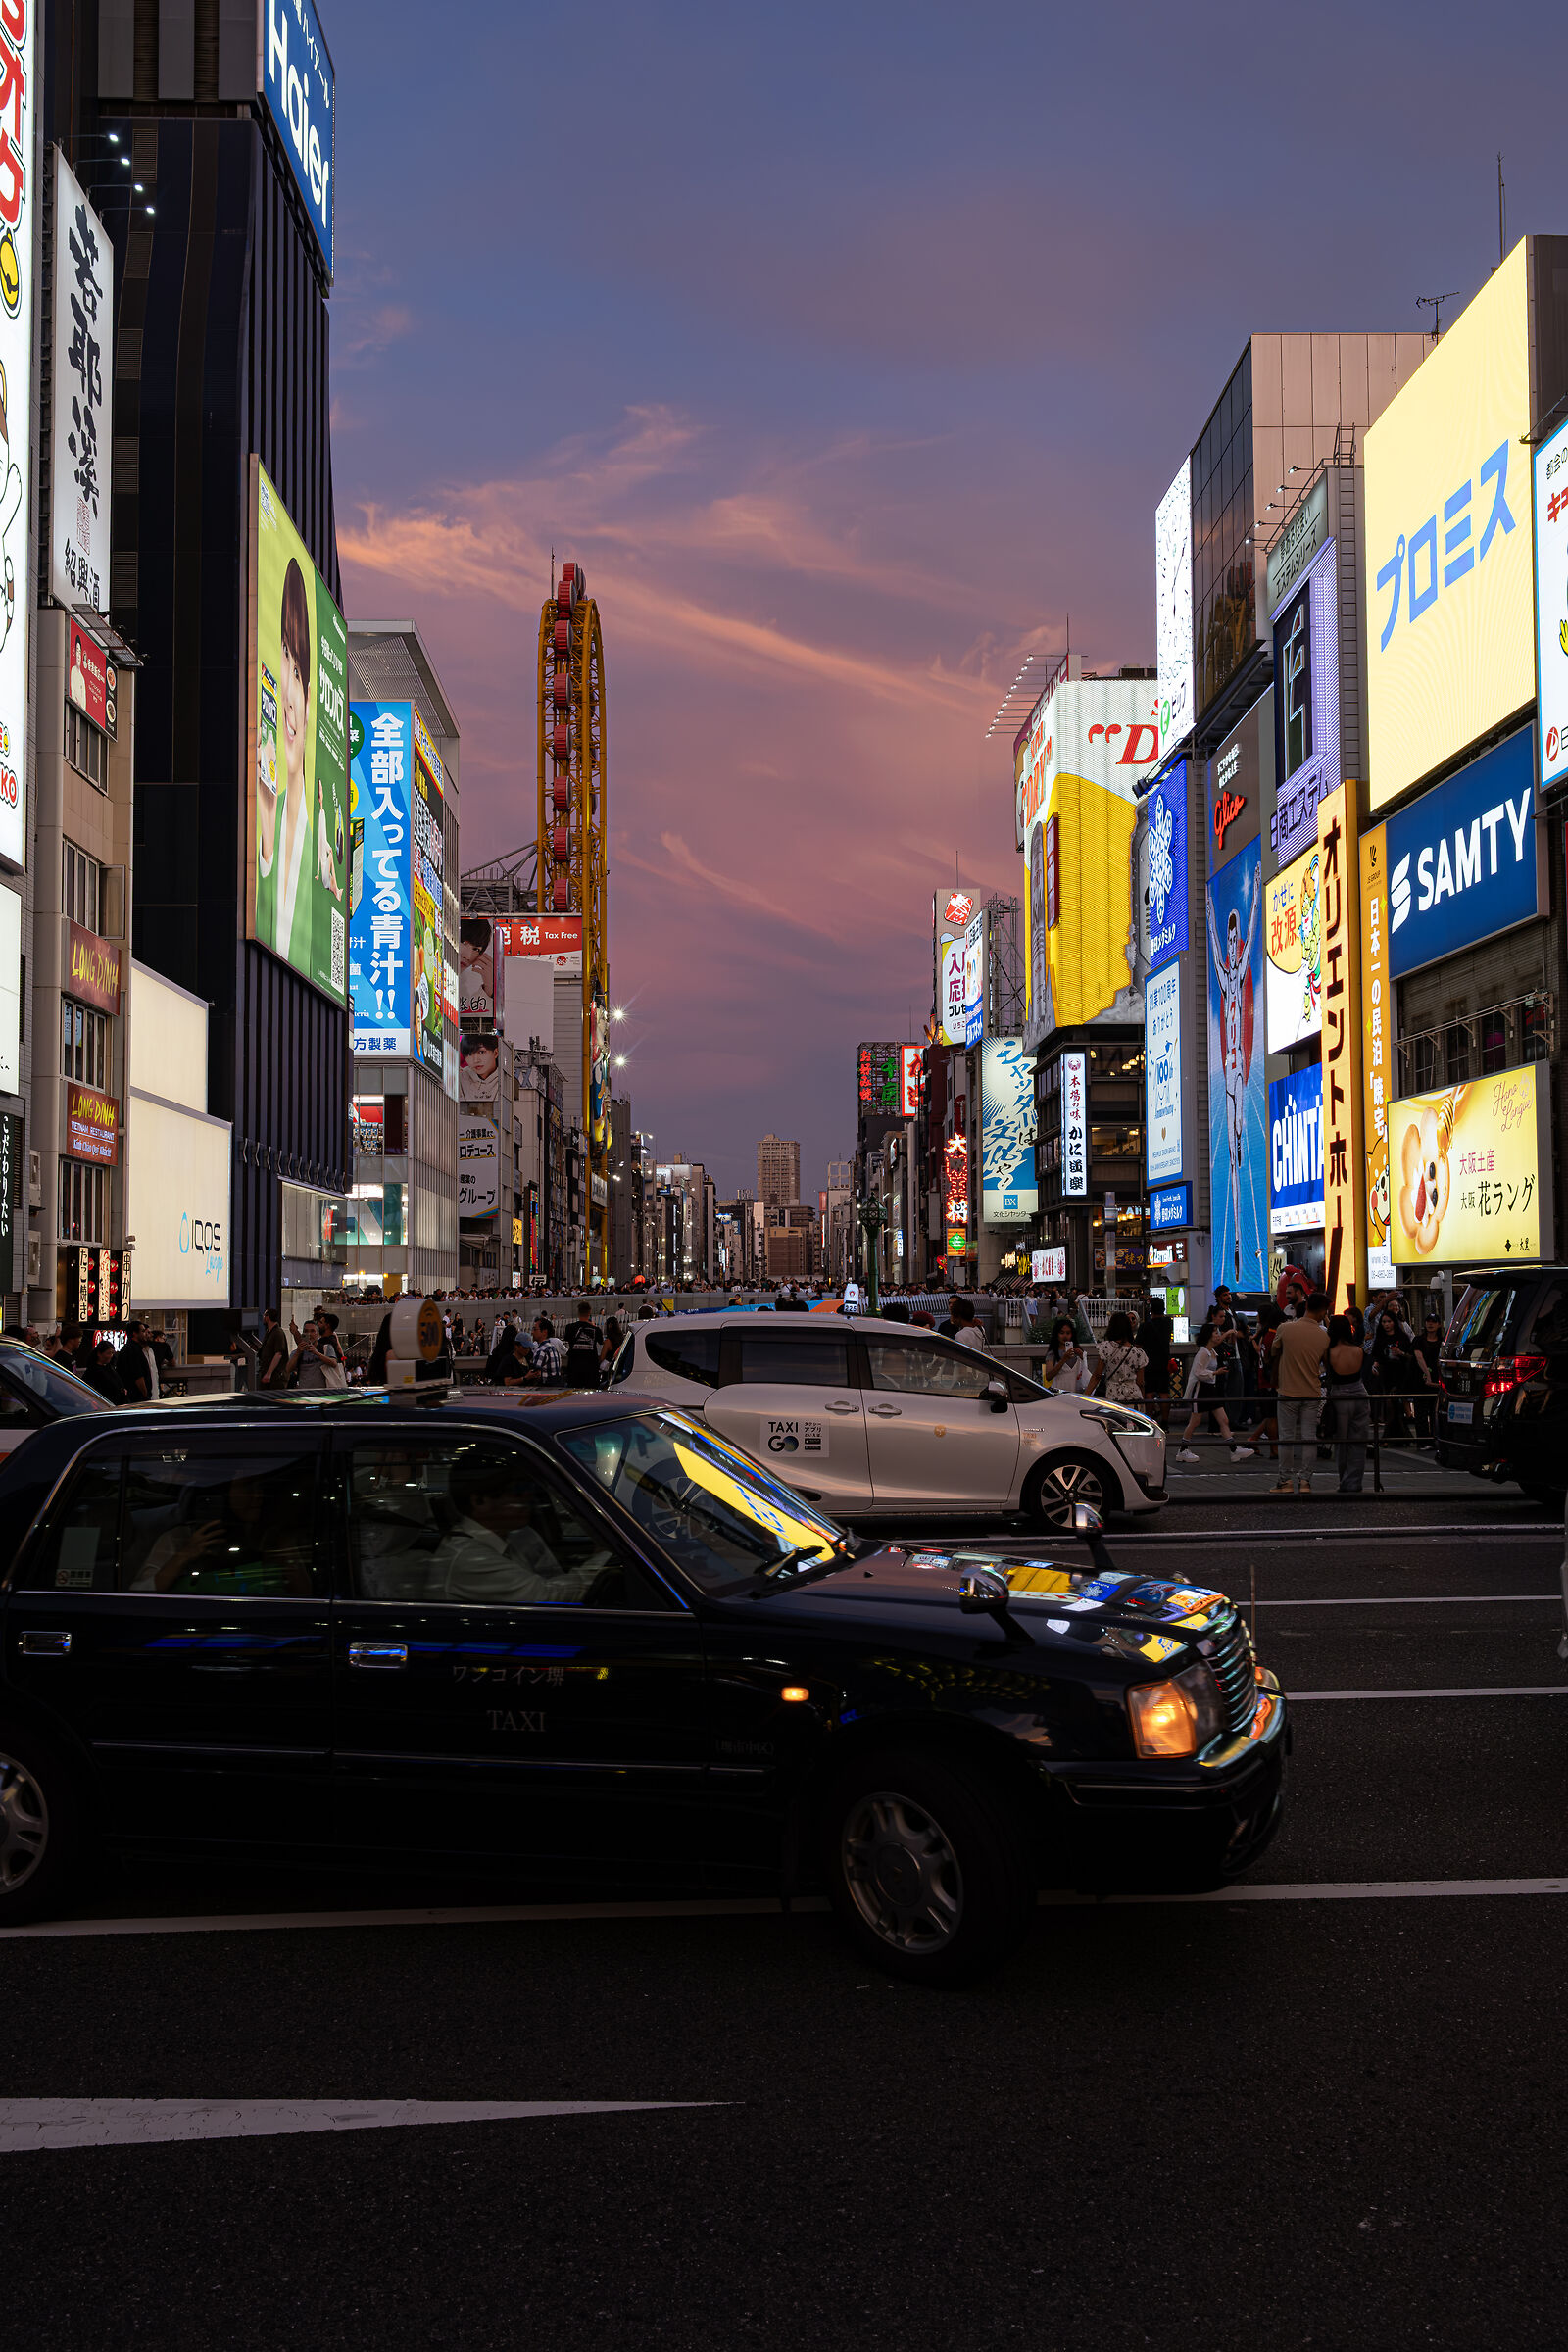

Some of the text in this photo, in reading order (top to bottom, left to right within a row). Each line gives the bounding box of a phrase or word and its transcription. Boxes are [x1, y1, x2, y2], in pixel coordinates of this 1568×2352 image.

[270, 0, 329, 228] Haier
[1376, 439, 1516, 652] プロミス
[1214, 791, 1246, 850] Glico
[370, 712, 404, 1020] 全部入ってる青汁!!
[1417, 787, 1532, 913] SAMTY
[1272, 882, 1295, 913] かぜに
[544, 931, 559, 940] Tax
[561, 931, 578, 940] Free
[1270, 905, 1298, 956] 改源
[72, 939, 119, 997] LONG DINH
[72, 1093, 116, 1127] LONG DINH
[1068, 1074, 1084, 1191] 本場の味 かに道楽
[1459, 1149, 1495, 1175] 大阪土産
[459, 1187, 496, 1205] グループ
[1004, 1198, 1017, 1206] BX
[1460, 1174, 1536, 1217] 大阪 花ラング
[191, 1219, 221, 1255] IQOS
[122, 1253, 130, 1320] 串かつ
[767, 1421, 799, 1433] TAXI
[767, 1435, 800, 1452] GO
[485, 1708, 549, 1733] TAXI
